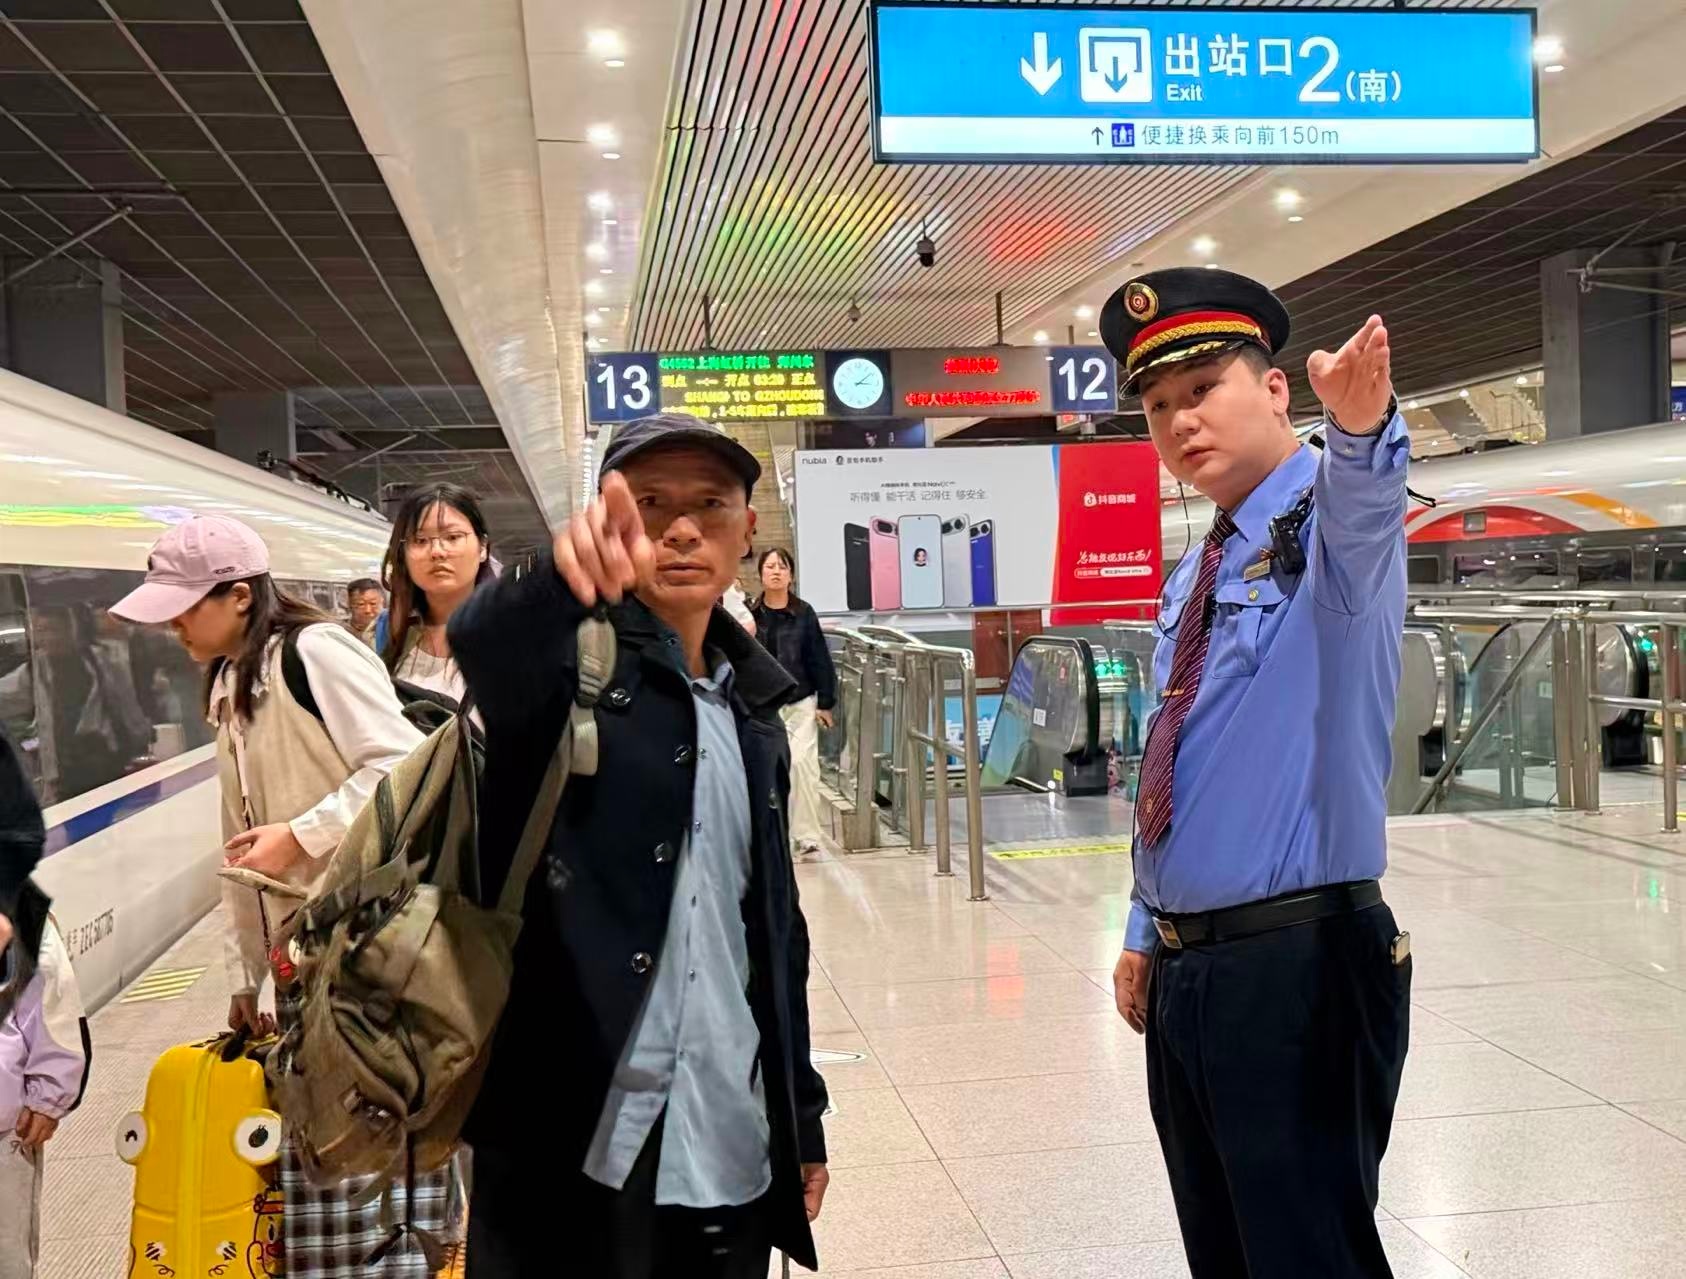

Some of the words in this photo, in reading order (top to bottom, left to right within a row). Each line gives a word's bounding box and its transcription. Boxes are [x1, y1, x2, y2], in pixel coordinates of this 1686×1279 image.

[1166, 83, 1203, 103] Exit
[1141, 125, 1341, 146] 便捷换乘向前150m
[596, 364, 652, 410] 13
[1057, 357, 1110, 401] 12
[732, 388, 752, 402] TO
[801, 456, 828, 466] nubia
[850, 491, 881, 503] 听得懂
[886, 490, 916, 502] 能干活
[921, 489, 951, 501] 记得住
[956, 488, 987, 500] 够安全
[1098, 493, 1137, 505] 抖音商城
